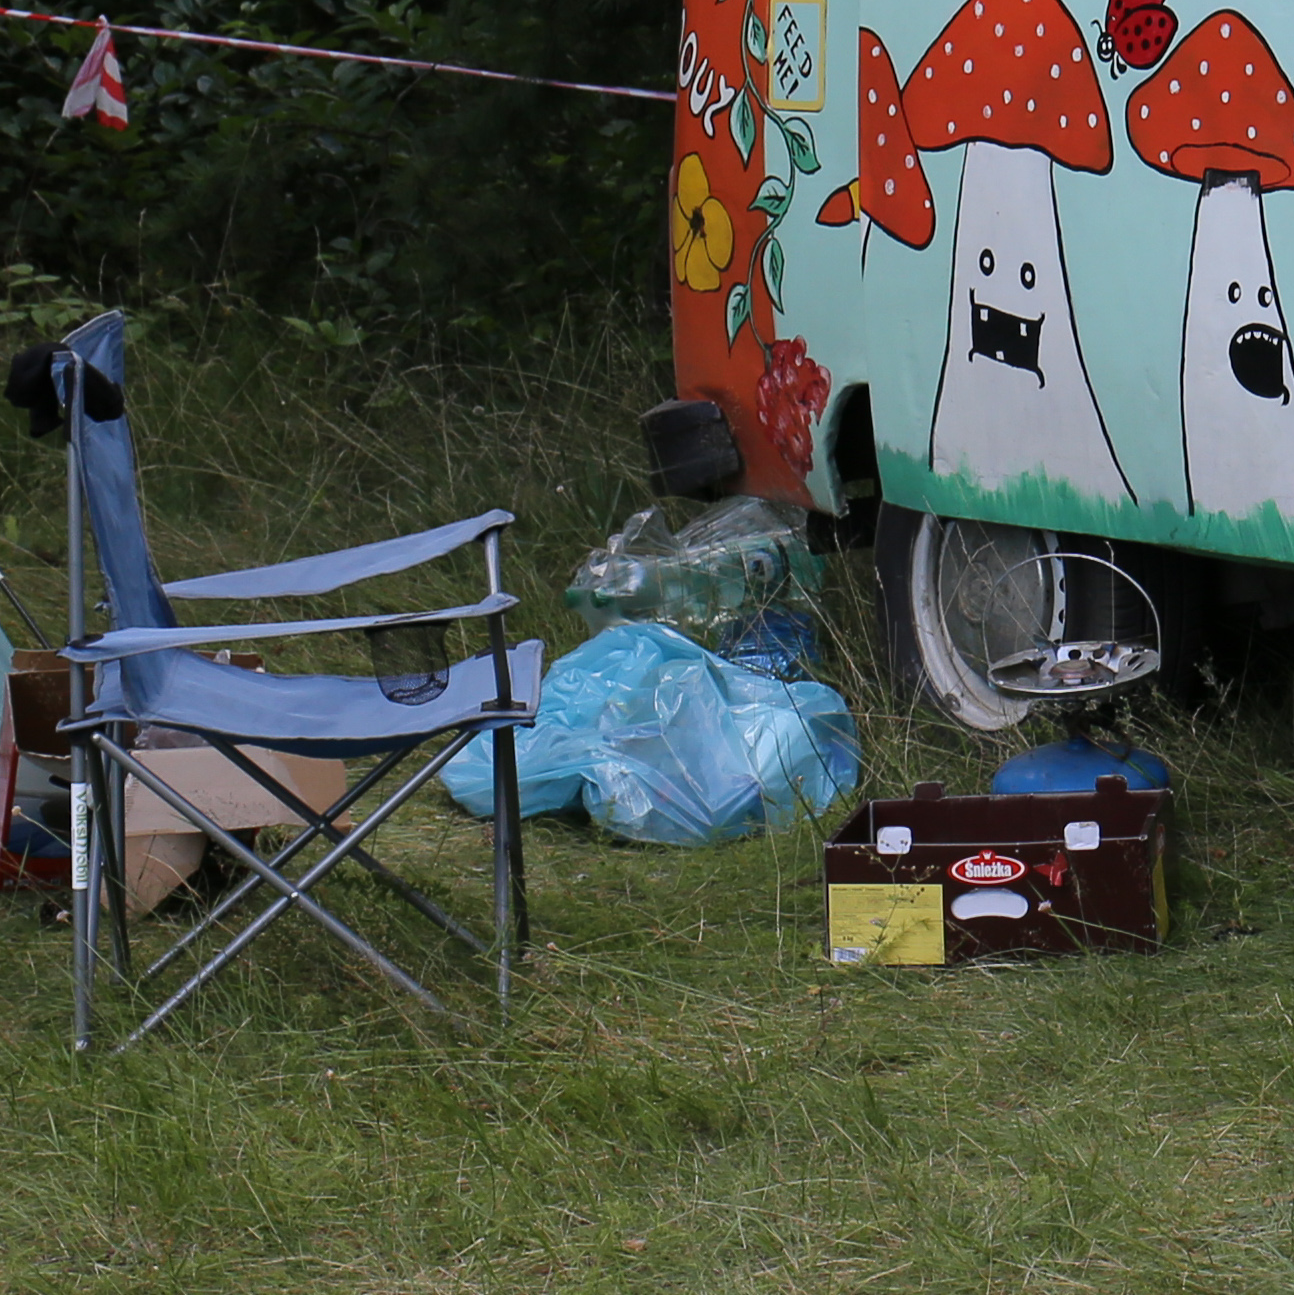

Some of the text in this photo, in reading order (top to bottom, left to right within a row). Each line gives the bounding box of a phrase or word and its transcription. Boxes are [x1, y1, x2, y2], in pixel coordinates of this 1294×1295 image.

[777, 4, 812, 78] FEED
[773, 50, 799, 100] ME!
[964, 859, 1012, 878] Śnieżka
